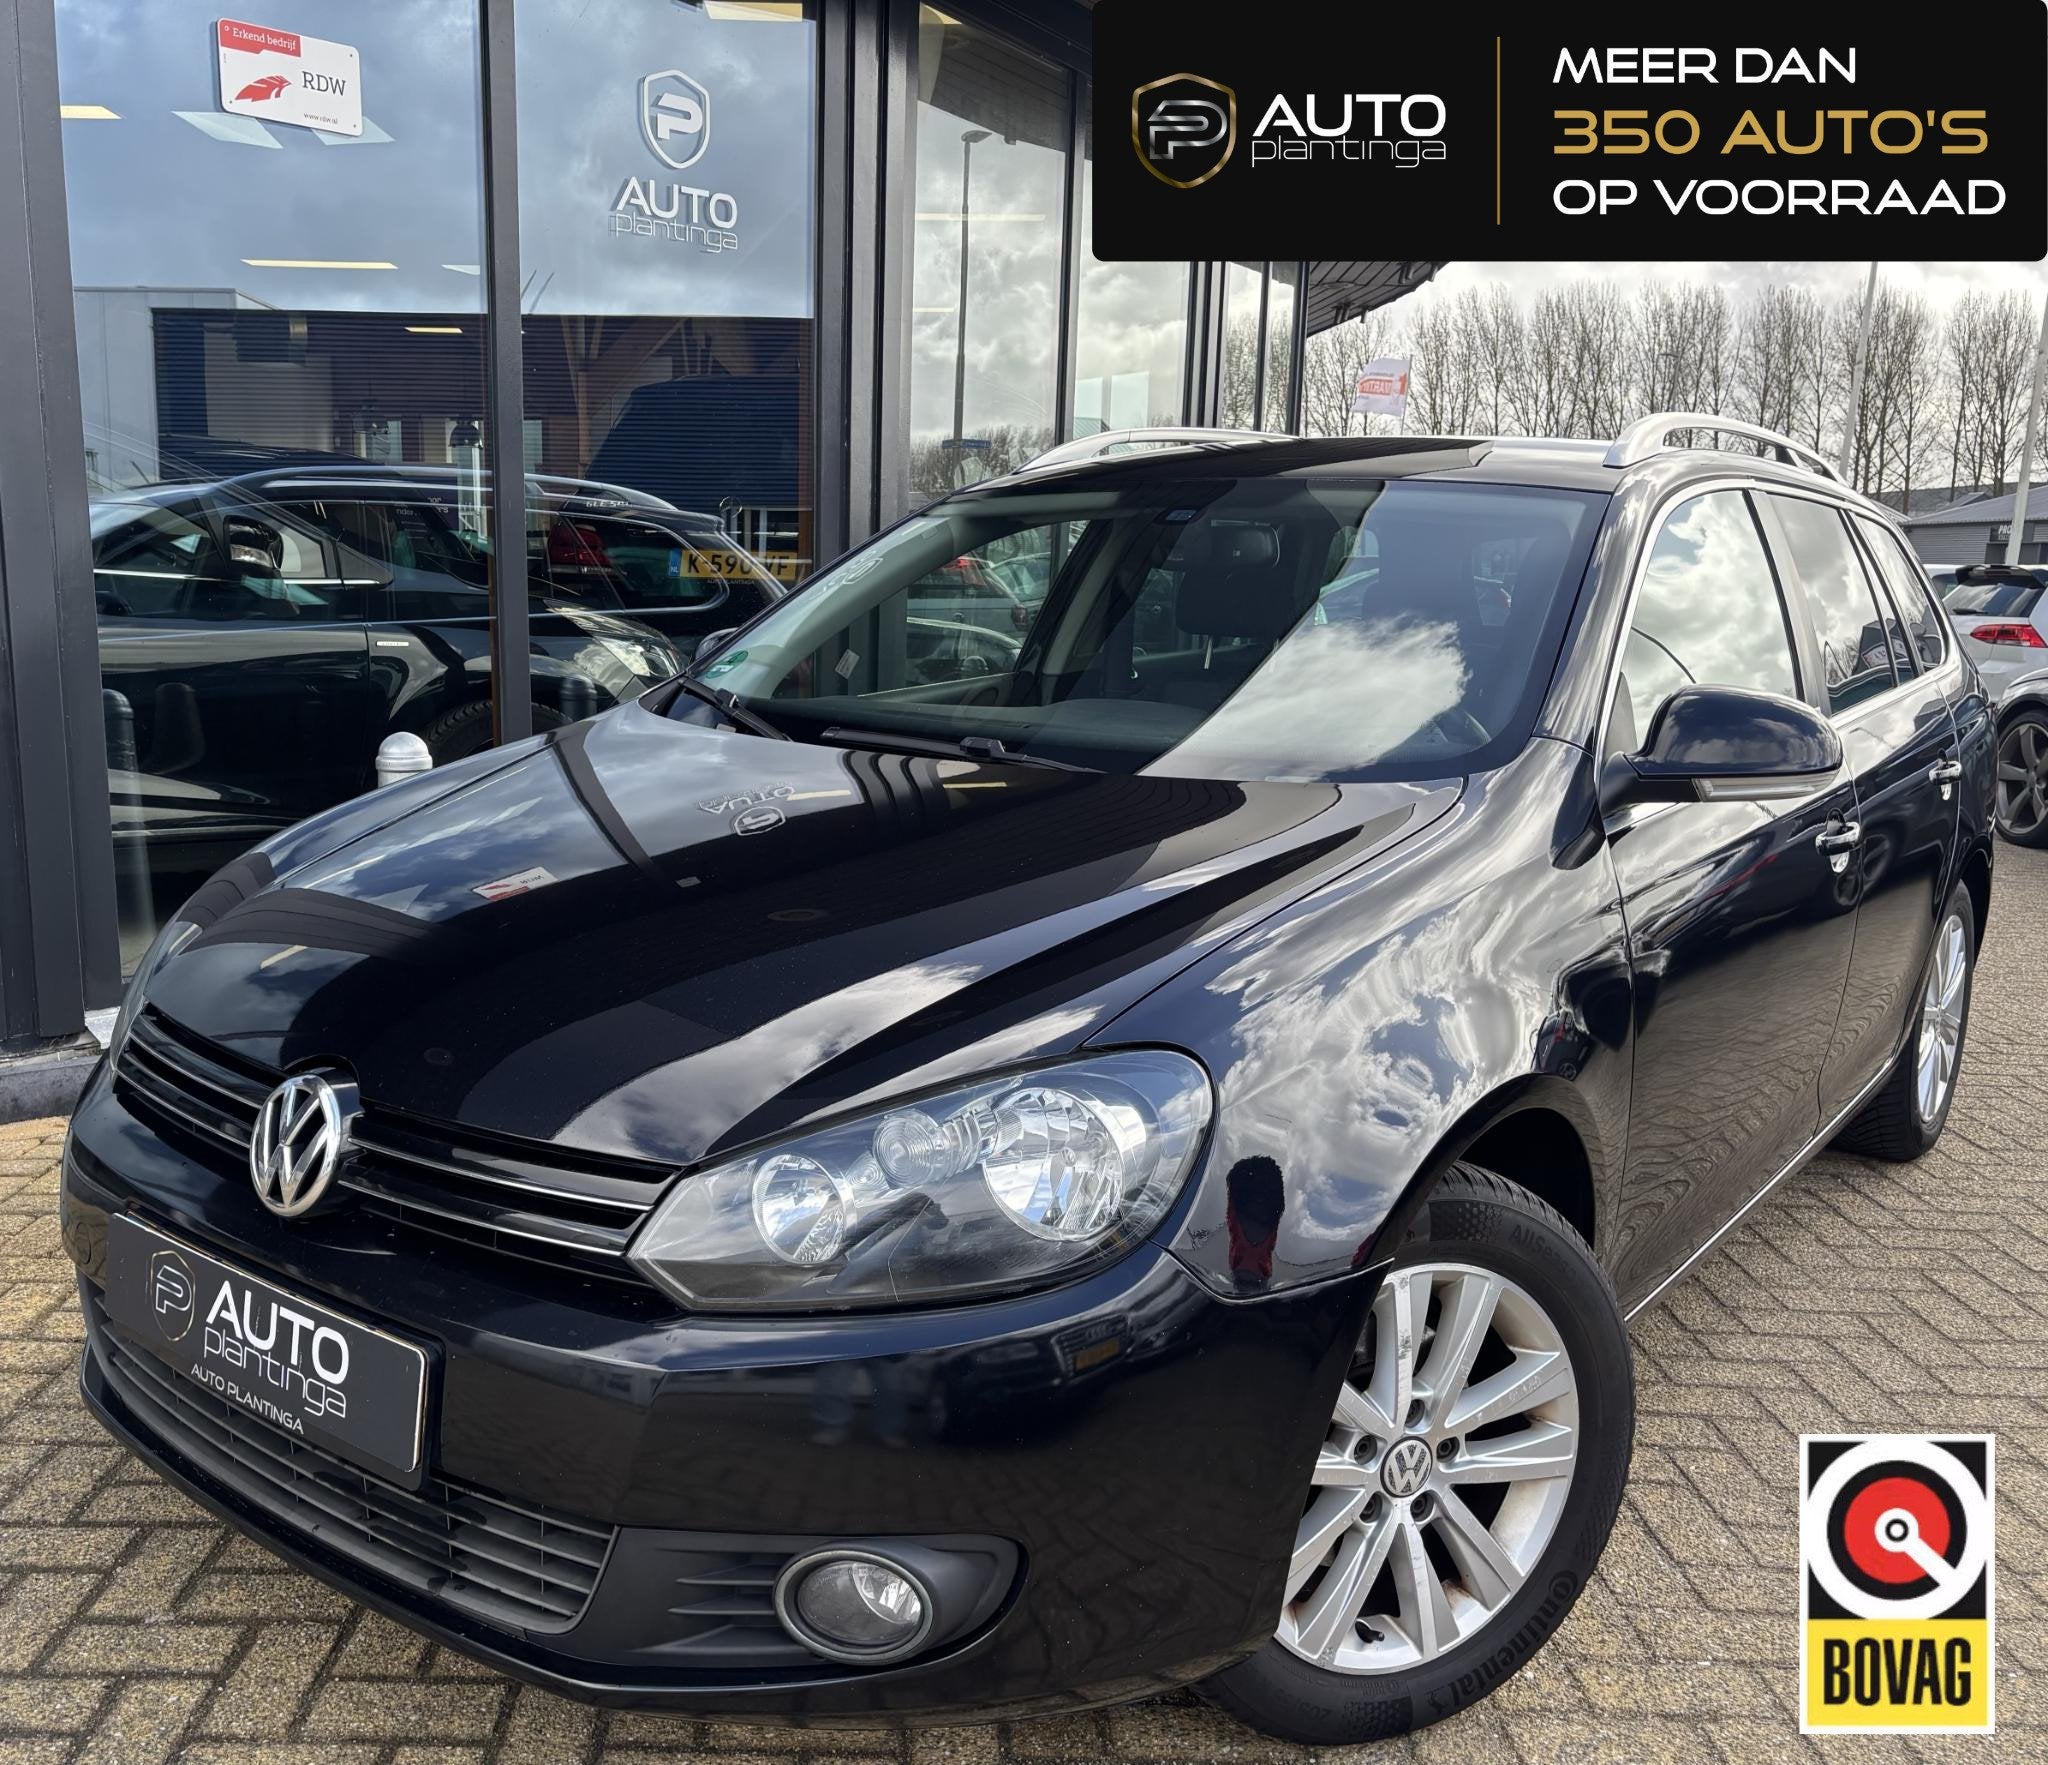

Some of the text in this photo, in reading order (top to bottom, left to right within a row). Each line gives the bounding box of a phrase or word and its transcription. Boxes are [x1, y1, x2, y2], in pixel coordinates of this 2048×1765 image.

[232, 27, 297, 51] Erkend bedrijf
[301, 70, 346, 97] RDW
[616, 176, 738, 229] AUTO
[615, 211, 738, 254] plantinga
[206, 1280, 350, 1385] AUTO
[190, 1362, 305, 1436] AUTO PLANTINGA
[203, 1326, 347, 1419] plantinga
